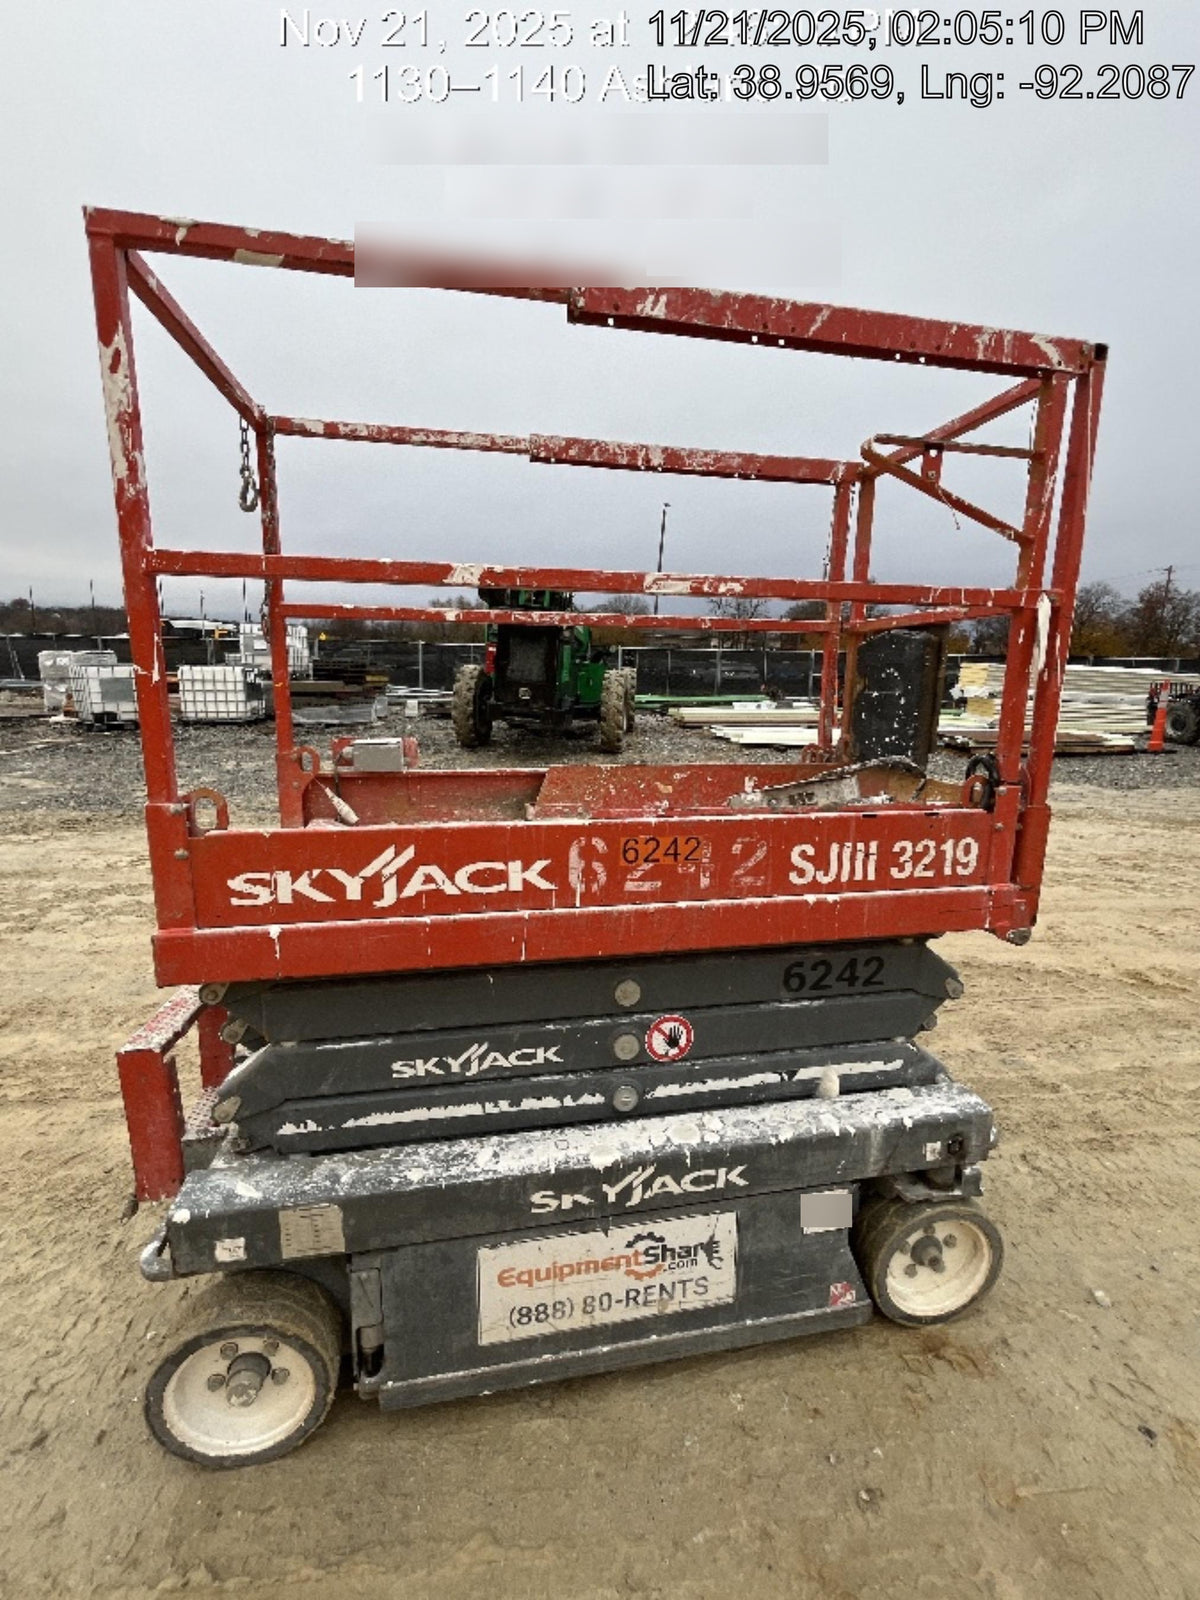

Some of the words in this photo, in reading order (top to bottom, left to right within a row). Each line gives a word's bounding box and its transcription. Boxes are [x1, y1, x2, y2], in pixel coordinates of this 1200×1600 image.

[622, 836, 701, 864] 6242
[889, 836, 980, 879] 3219
[226, 843, 558, 908] SKYJACK
[782, 955, 885, 993] 6242
[391, 1041, 564, 1079] SKYJACK
[530, 1163, 749, 1213] SKYJACK
[508, 1297, 575, 1329] (888)
